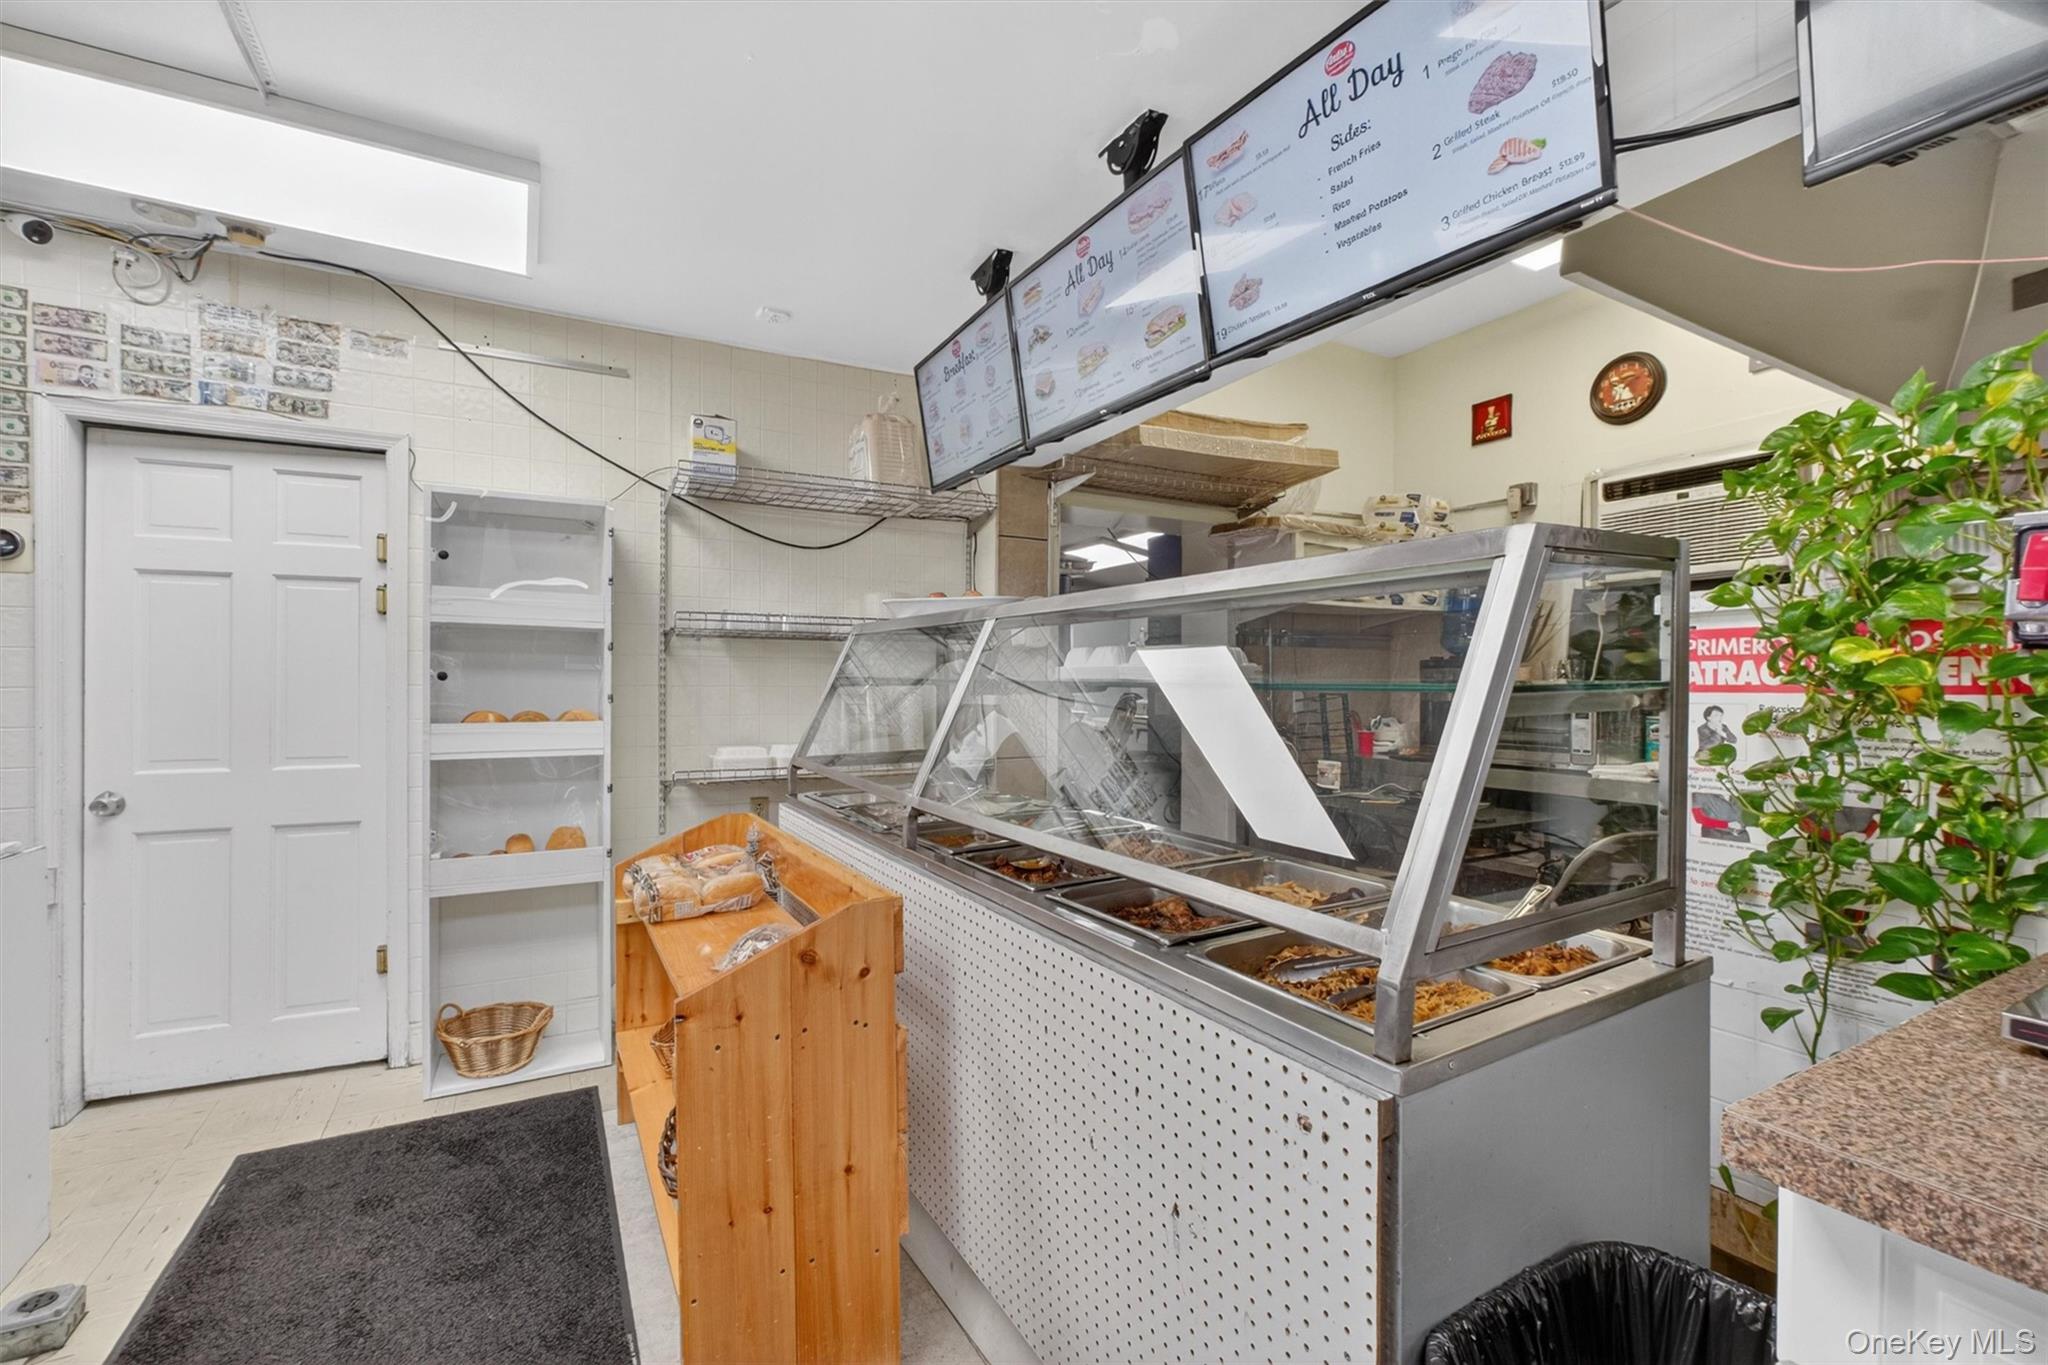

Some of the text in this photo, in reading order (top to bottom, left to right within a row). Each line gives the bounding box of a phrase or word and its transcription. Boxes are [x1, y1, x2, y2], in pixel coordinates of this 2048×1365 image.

[1422, 64, 1430, 79] 1
[1299, 83, 1342, 139] All
[1347, 52, 1404, 102] Day
[1331, 119, 1372, 152] Sides:
[1432, 109, 1501, 161] 2 Grilled Steak
[1328, 139, 1382, 176] French Fries
[1330, 176, 1354, 195] Salad
[1441, 215, 1451, 231] 3
[1452, 199, 1482, 220] Grilled
[1483, 182, 1519, 205] Chicken
[1521, 165, 1553, 187] Breast
[1332, 198, 1352, 213] Rice
[1334, 187, 1409, 231] Mashed Potatoes
[1336, 221, 1383, 249] Vegetables
[1065, 250, 1114, 296] All Day
[1689, 637, 1790, 657] PRIMER
